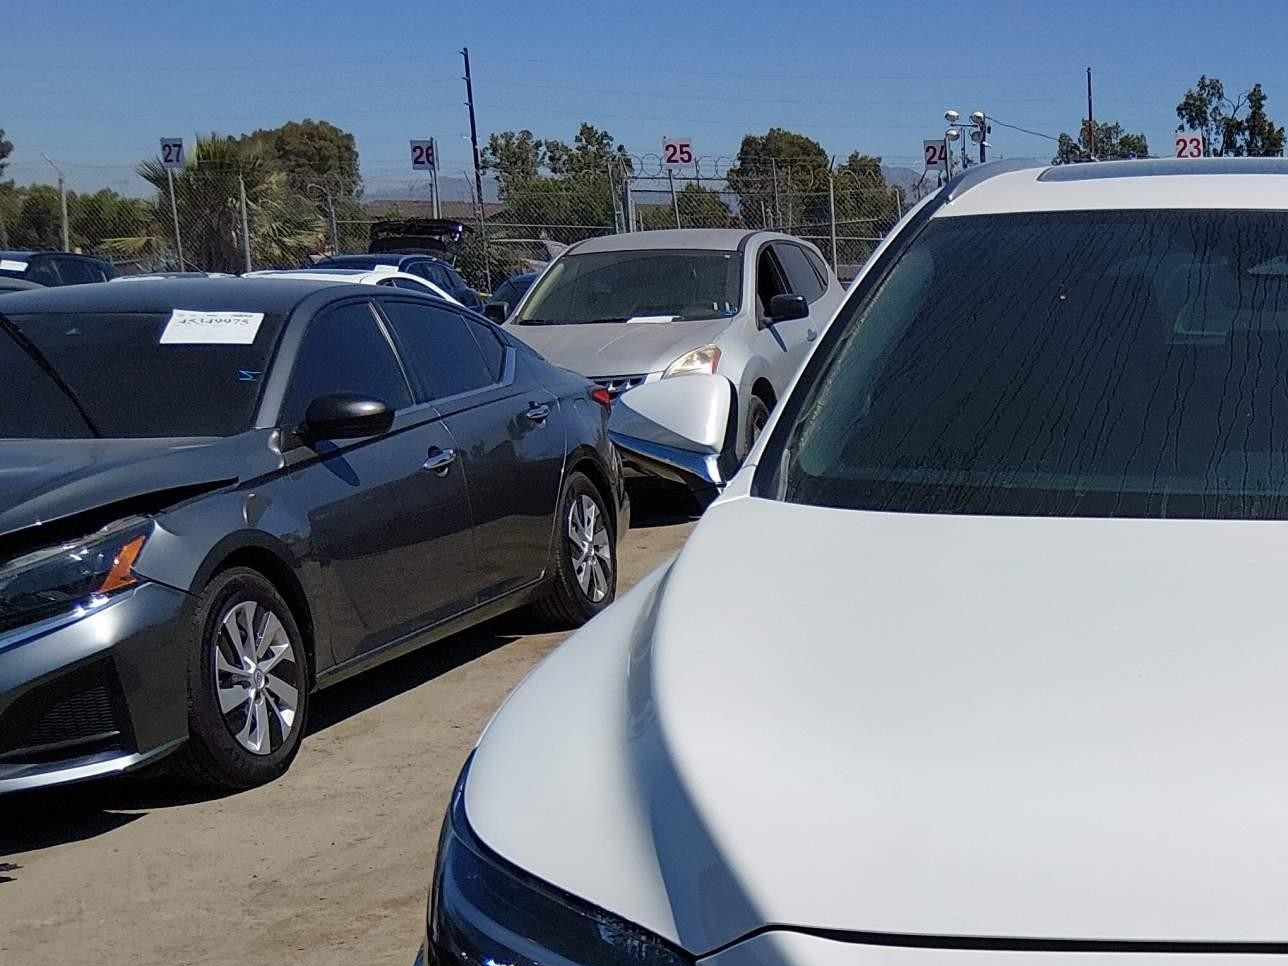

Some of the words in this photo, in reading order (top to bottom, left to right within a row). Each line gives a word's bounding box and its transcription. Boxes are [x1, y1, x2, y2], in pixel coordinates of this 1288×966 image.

[162, 143, 182, 163] 27
[412, 145, 434, 165] 26
[665, 143, 692, 163] 25
[1175, 137, 1201, 158] 23
